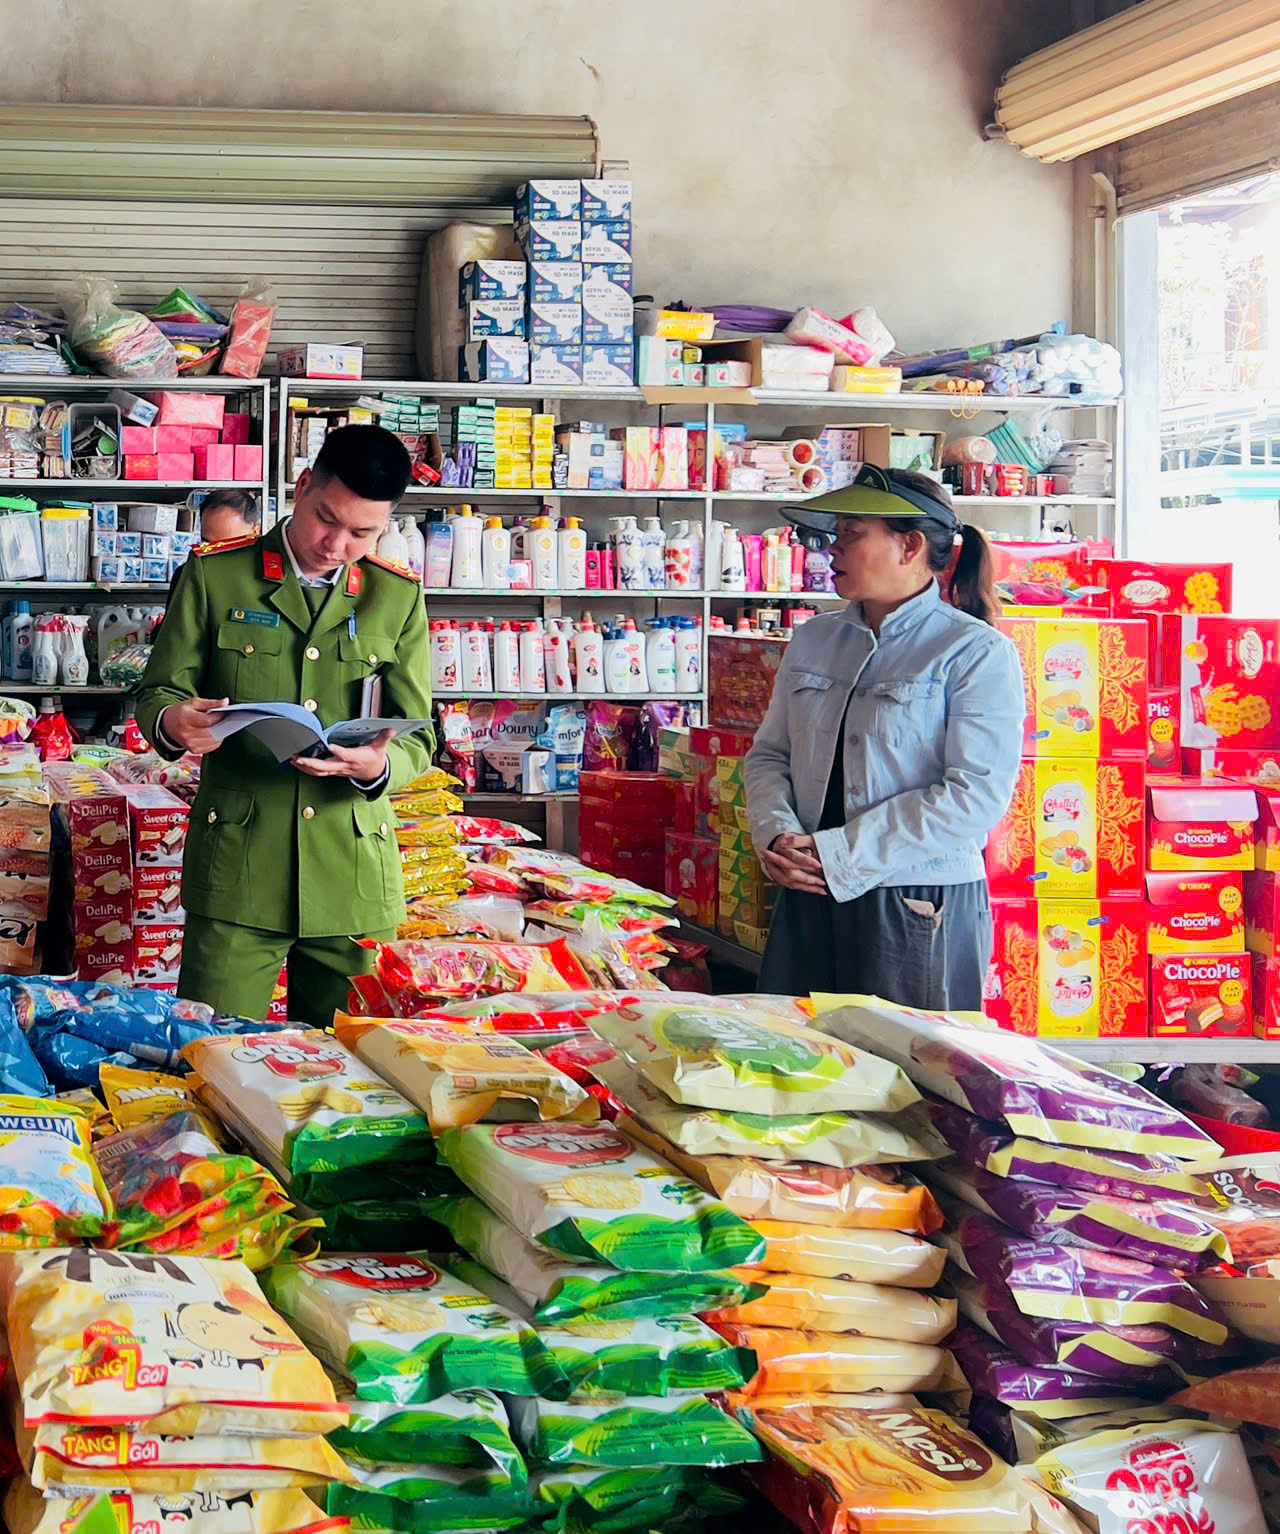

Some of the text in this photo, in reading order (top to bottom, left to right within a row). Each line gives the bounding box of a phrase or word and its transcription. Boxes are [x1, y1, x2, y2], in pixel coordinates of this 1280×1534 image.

[497, 722, 539, 737] Downy
[81, 804, 119, 816] DeliPie
[1174, 832, 1227, 844] ChocoPie
[85, 855, 122, 867] DeliPie
[86, 904, 124, 917] DeliPie
[1170, 916, 1220, 927] ChocoPie
[87, 953, 125, 966] DeliPie
[1164, 963, 1240, 981] ChocoPie
[305, 1256, 429, 1280] One One
[119, 1349, 137, 1390] 1
[129, 1442, 157, 1462] GÓI
